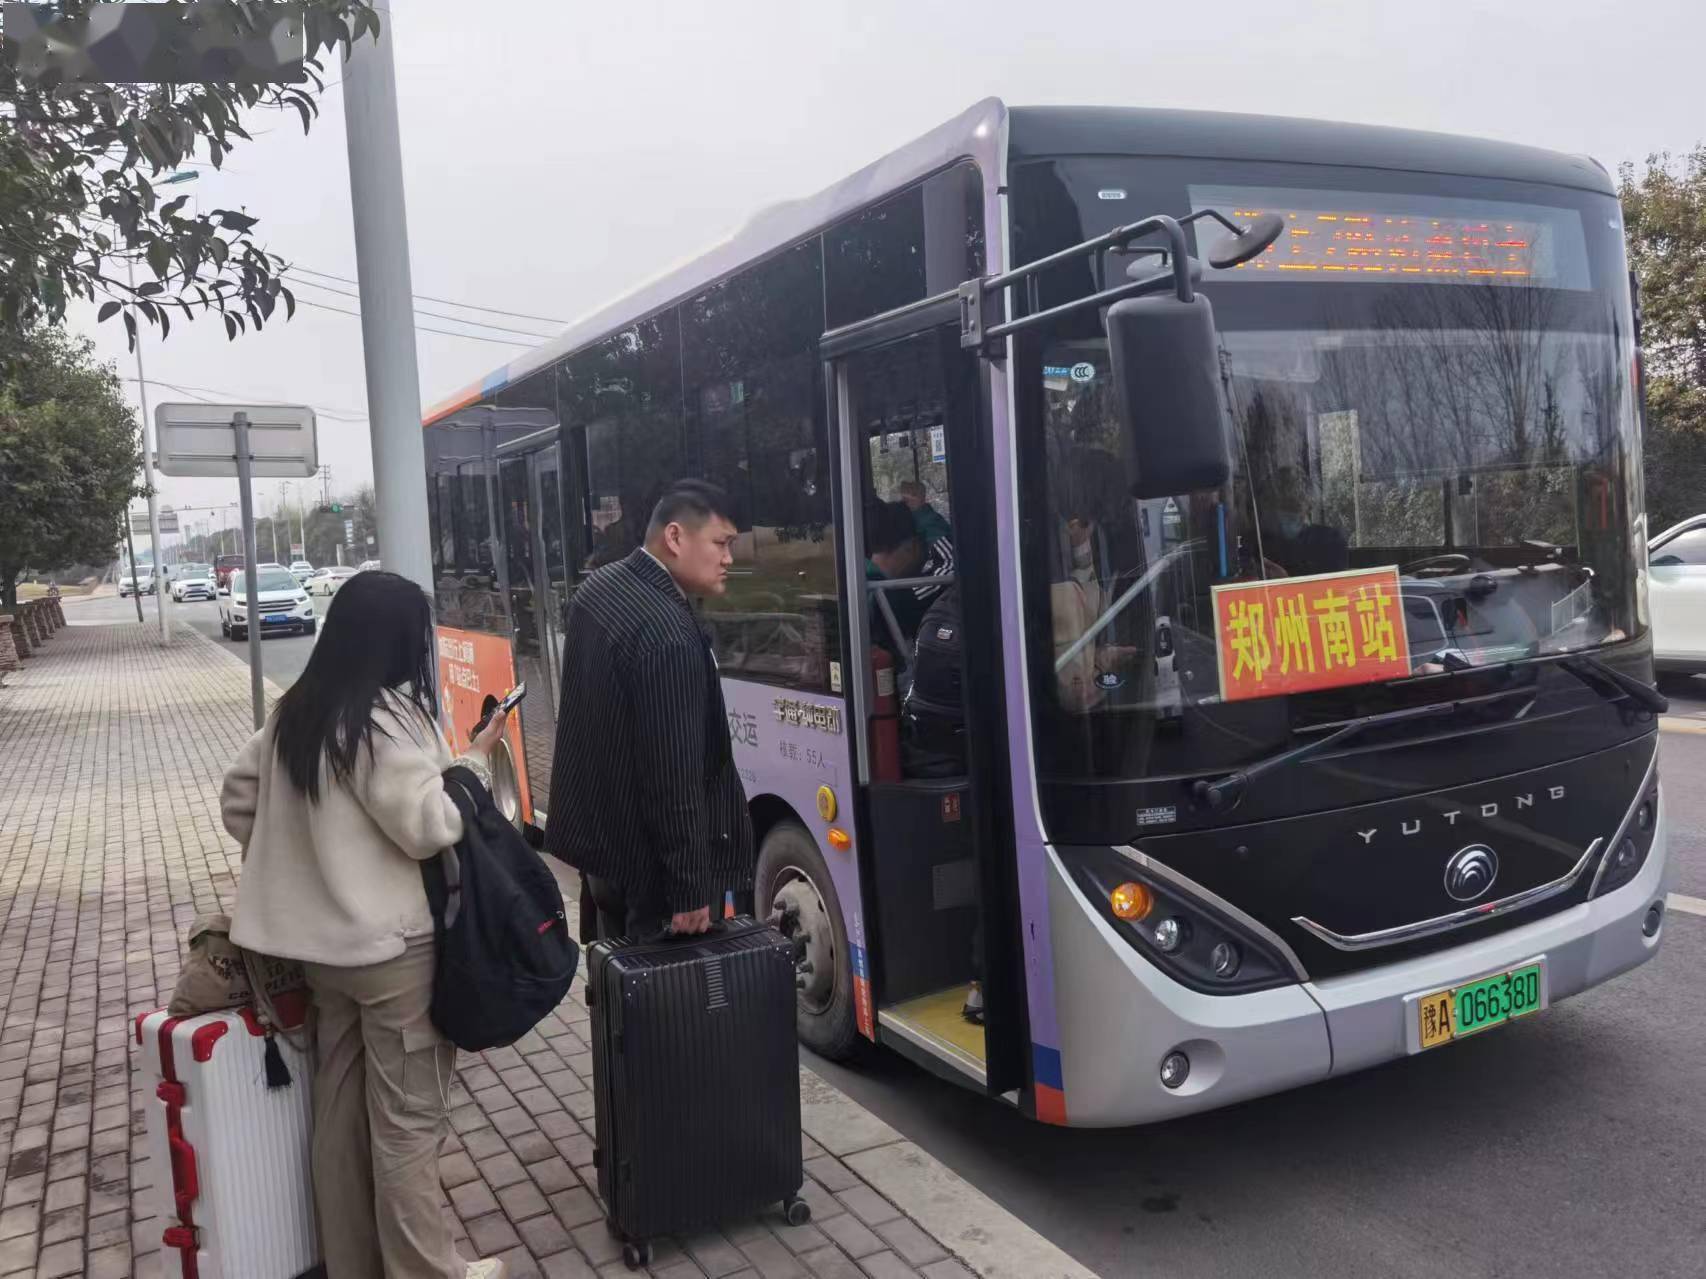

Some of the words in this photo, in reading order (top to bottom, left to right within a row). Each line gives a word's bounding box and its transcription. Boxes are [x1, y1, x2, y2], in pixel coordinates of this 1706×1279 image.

[1226, 583, 1397, 681] 郑州南站
[728, 708, 758, 748] 交运
[1357, 786, 1565, 844] YUTONG
